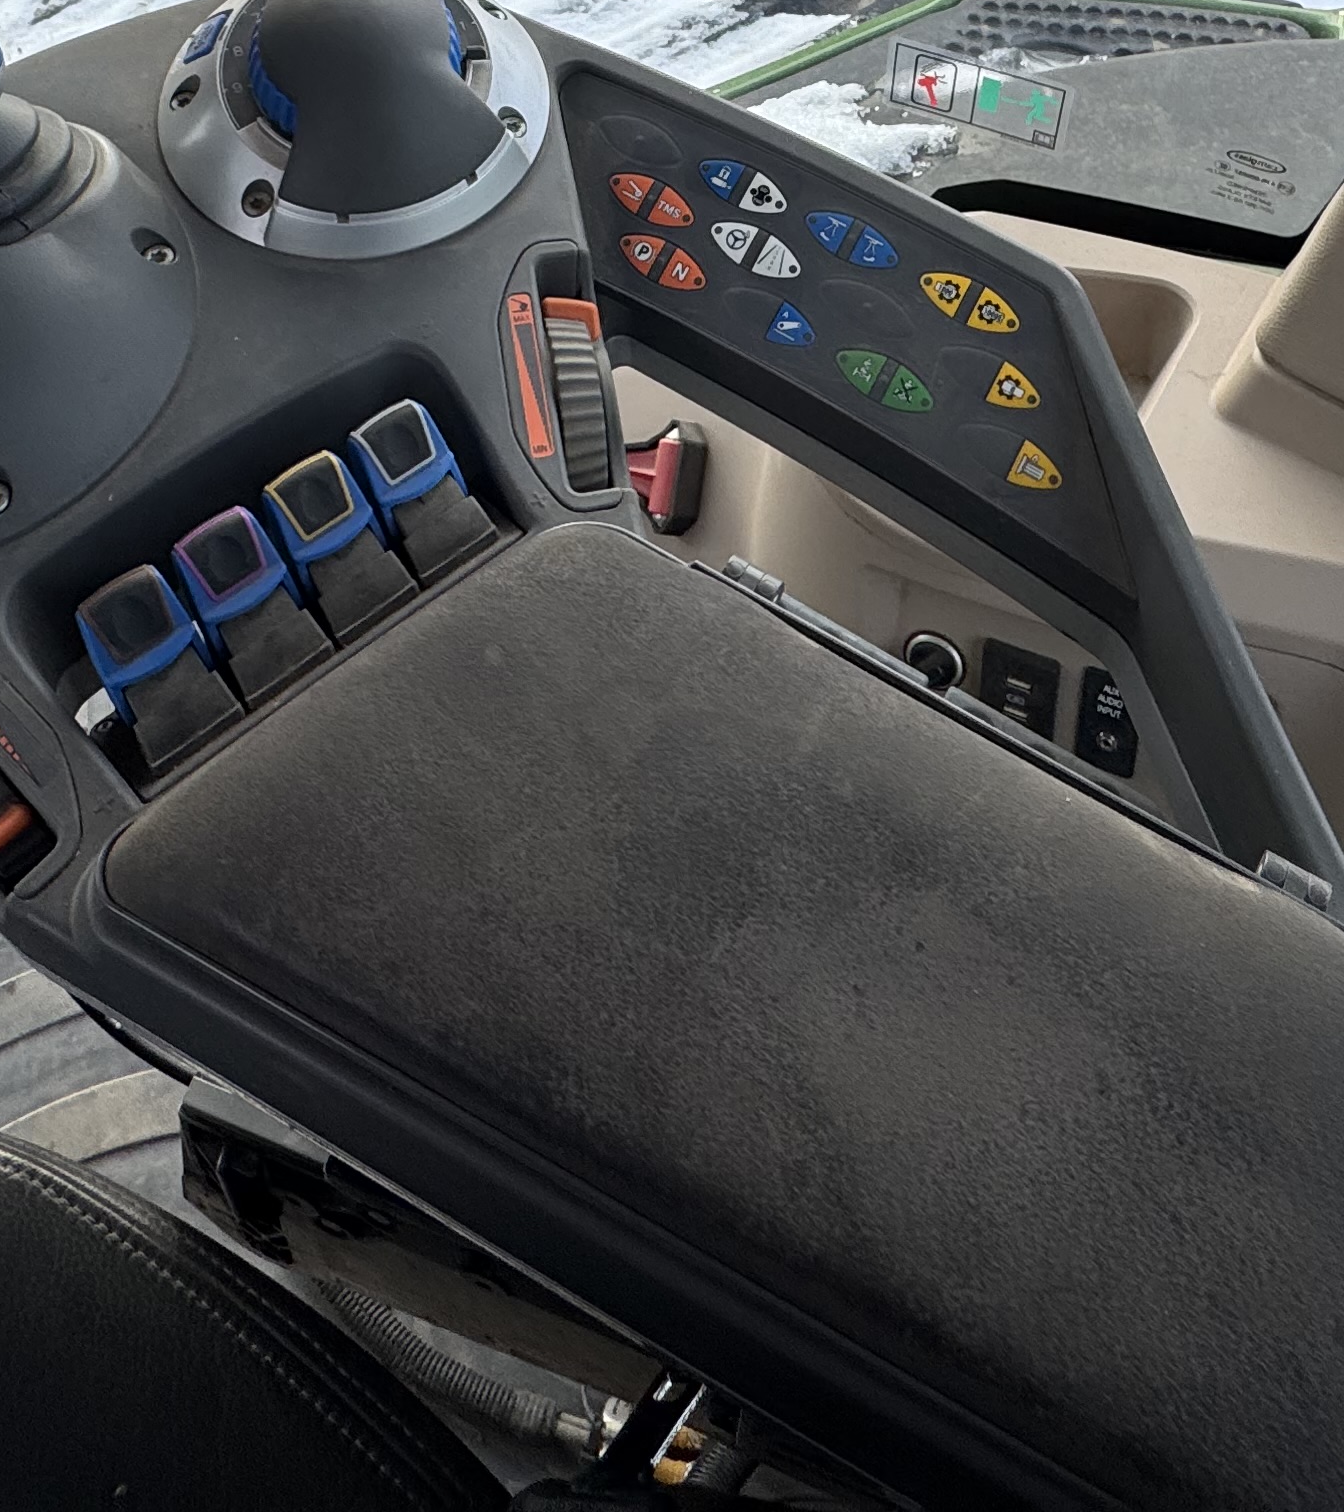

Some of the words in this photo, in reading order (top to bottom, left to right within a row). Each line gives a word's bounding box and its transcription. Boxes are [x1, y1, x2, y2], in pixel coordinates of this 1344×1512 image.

[657, 199, 682, 219] TMS
[637, 244, 650, 258] P
[671, 261, 690, 282] N
[513, 314, 530, 324] MAX
[532, 444, 548, 455] MIN
[1097, 694, 1124, 709] AUDIO
[1096, 704, 1122, 719] INPUT
